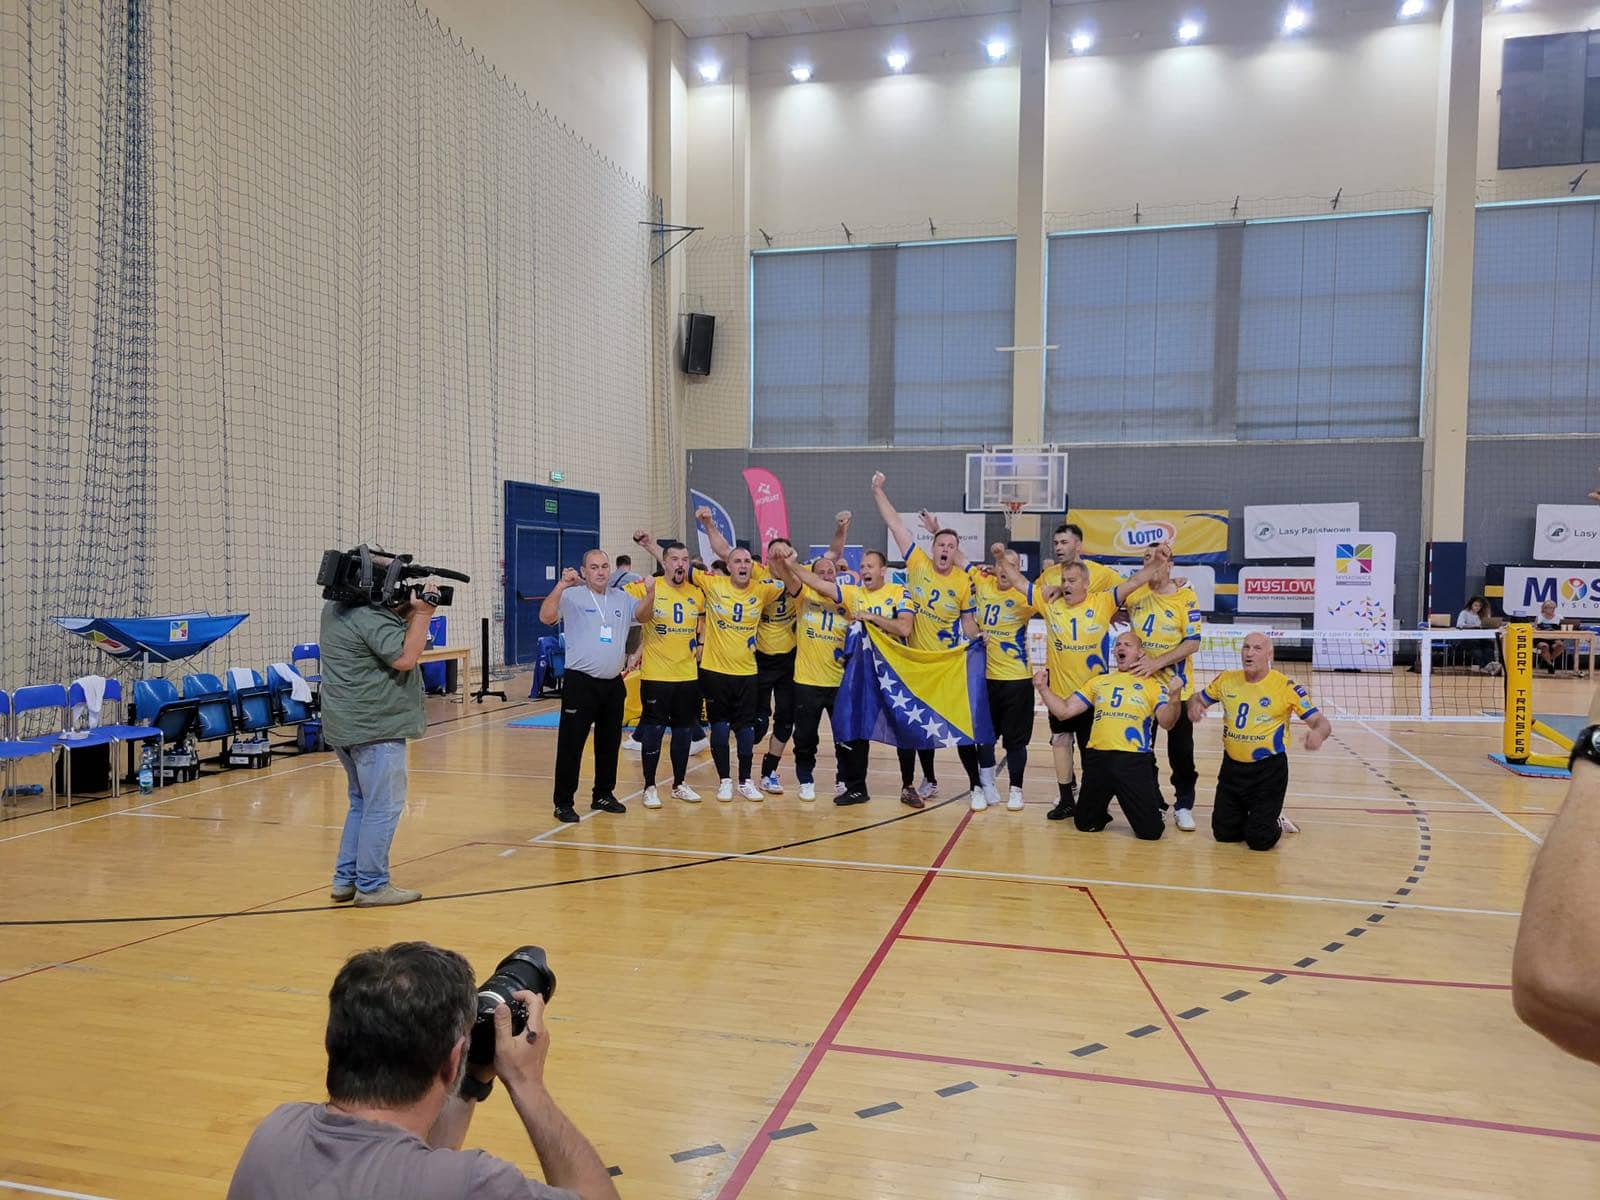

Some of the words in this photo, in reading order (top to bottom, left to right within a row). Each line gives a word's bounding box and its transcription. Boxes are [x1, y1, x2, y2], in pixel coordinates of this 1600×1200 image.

[1128, 528, 1163, 545] LOTTO
[1279, 527, 1299, 536] Lasy
[1574, 529, 1597, 539] Lasy
[927, 589, 940, 609] 2
[673, 603, 683, 624] 6
[733, 603, 743, 622] 9
[821, 610, 834, 631] 11
[983, 604, 1000, 626] 13
[1070, 618, 1077, 640] 1
[1142, 614, 1155, 637] 4
[1517, 636, 1526, 675] SPORT
[1110, 687, 1124, 708] 5
[1235, 703, 1249, 729] 8
[1515, 690, 1526, 753] TRANSFER
